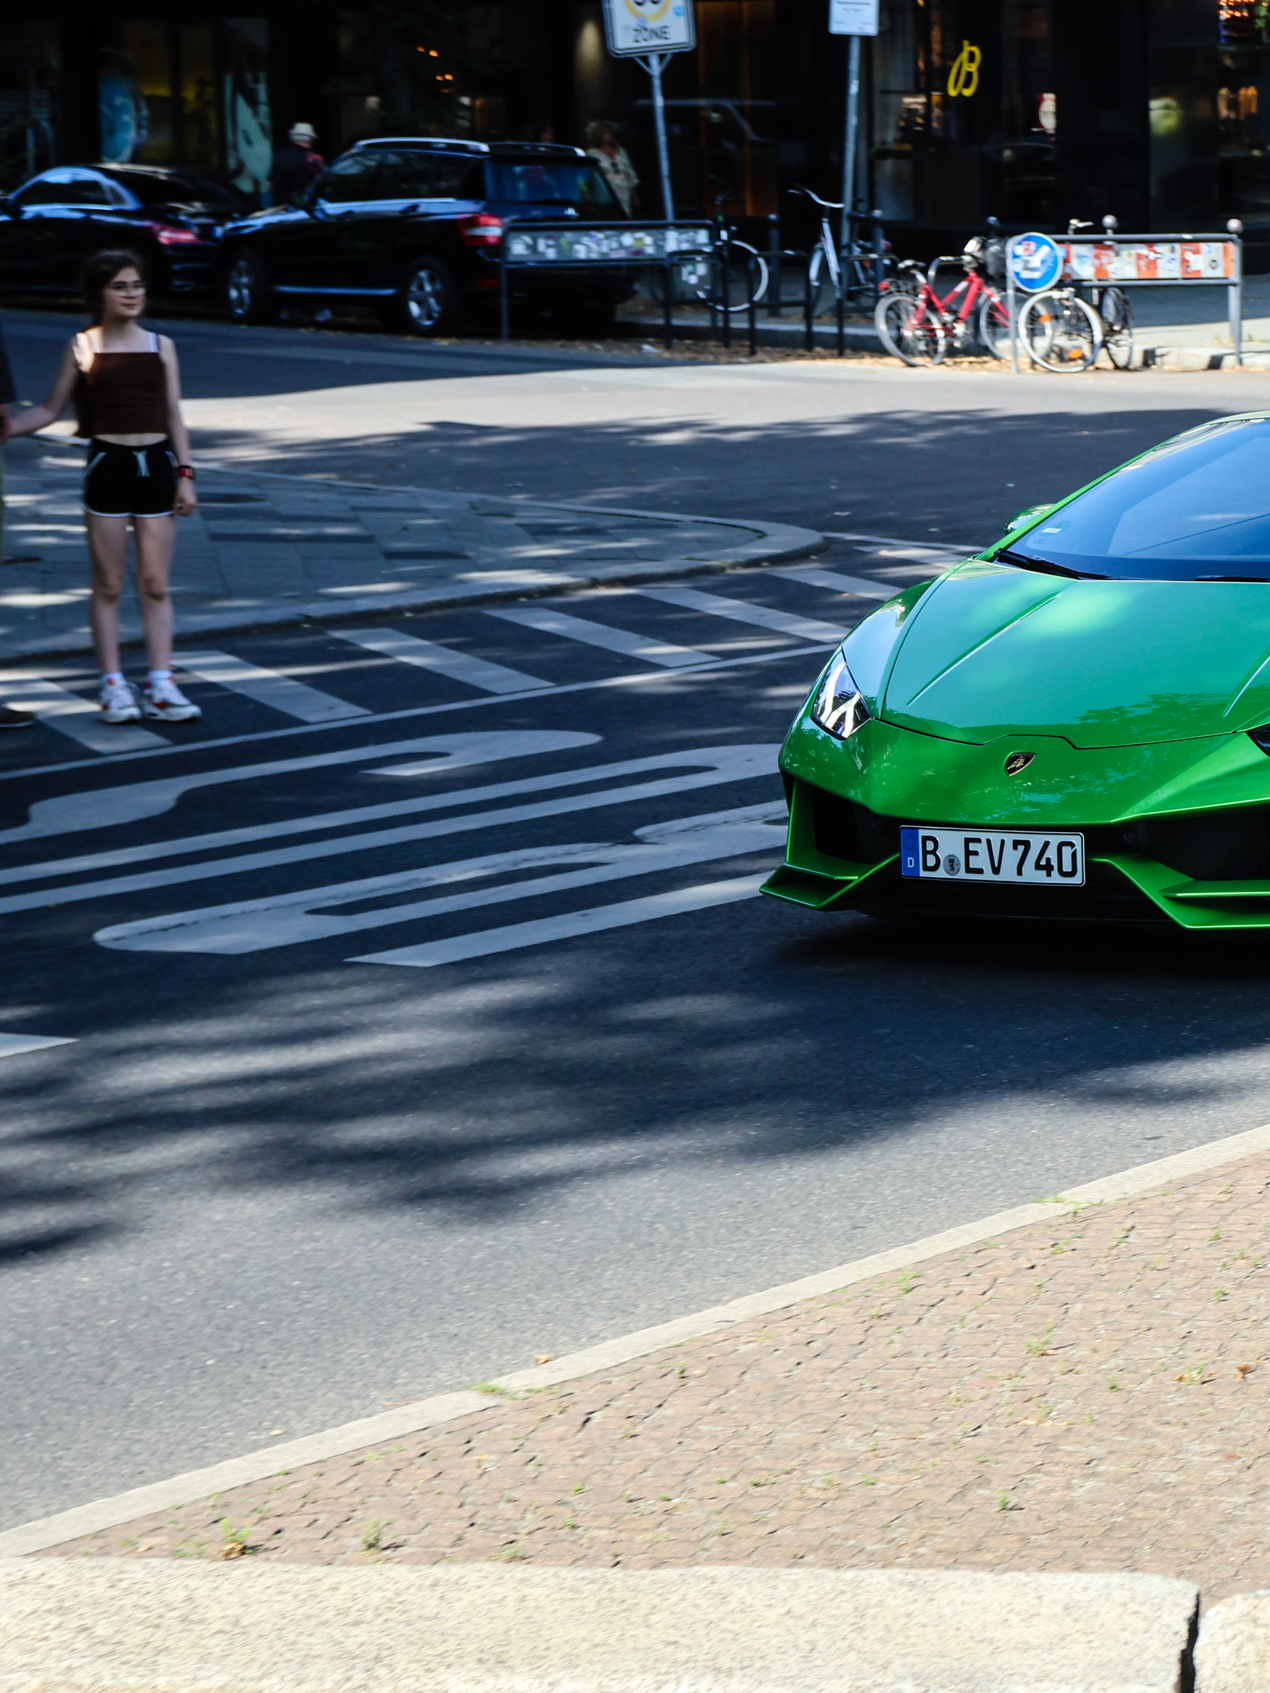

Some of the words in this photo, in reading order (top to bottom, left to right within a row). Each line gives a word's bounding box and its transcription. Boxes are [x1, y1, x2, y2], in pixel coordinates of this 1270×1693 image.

[632, 25, 671, 43] ZONE
[947, 39, 982, 97] B
[907, 856, 915, 869] D
[921, 834, 942, 873] B
